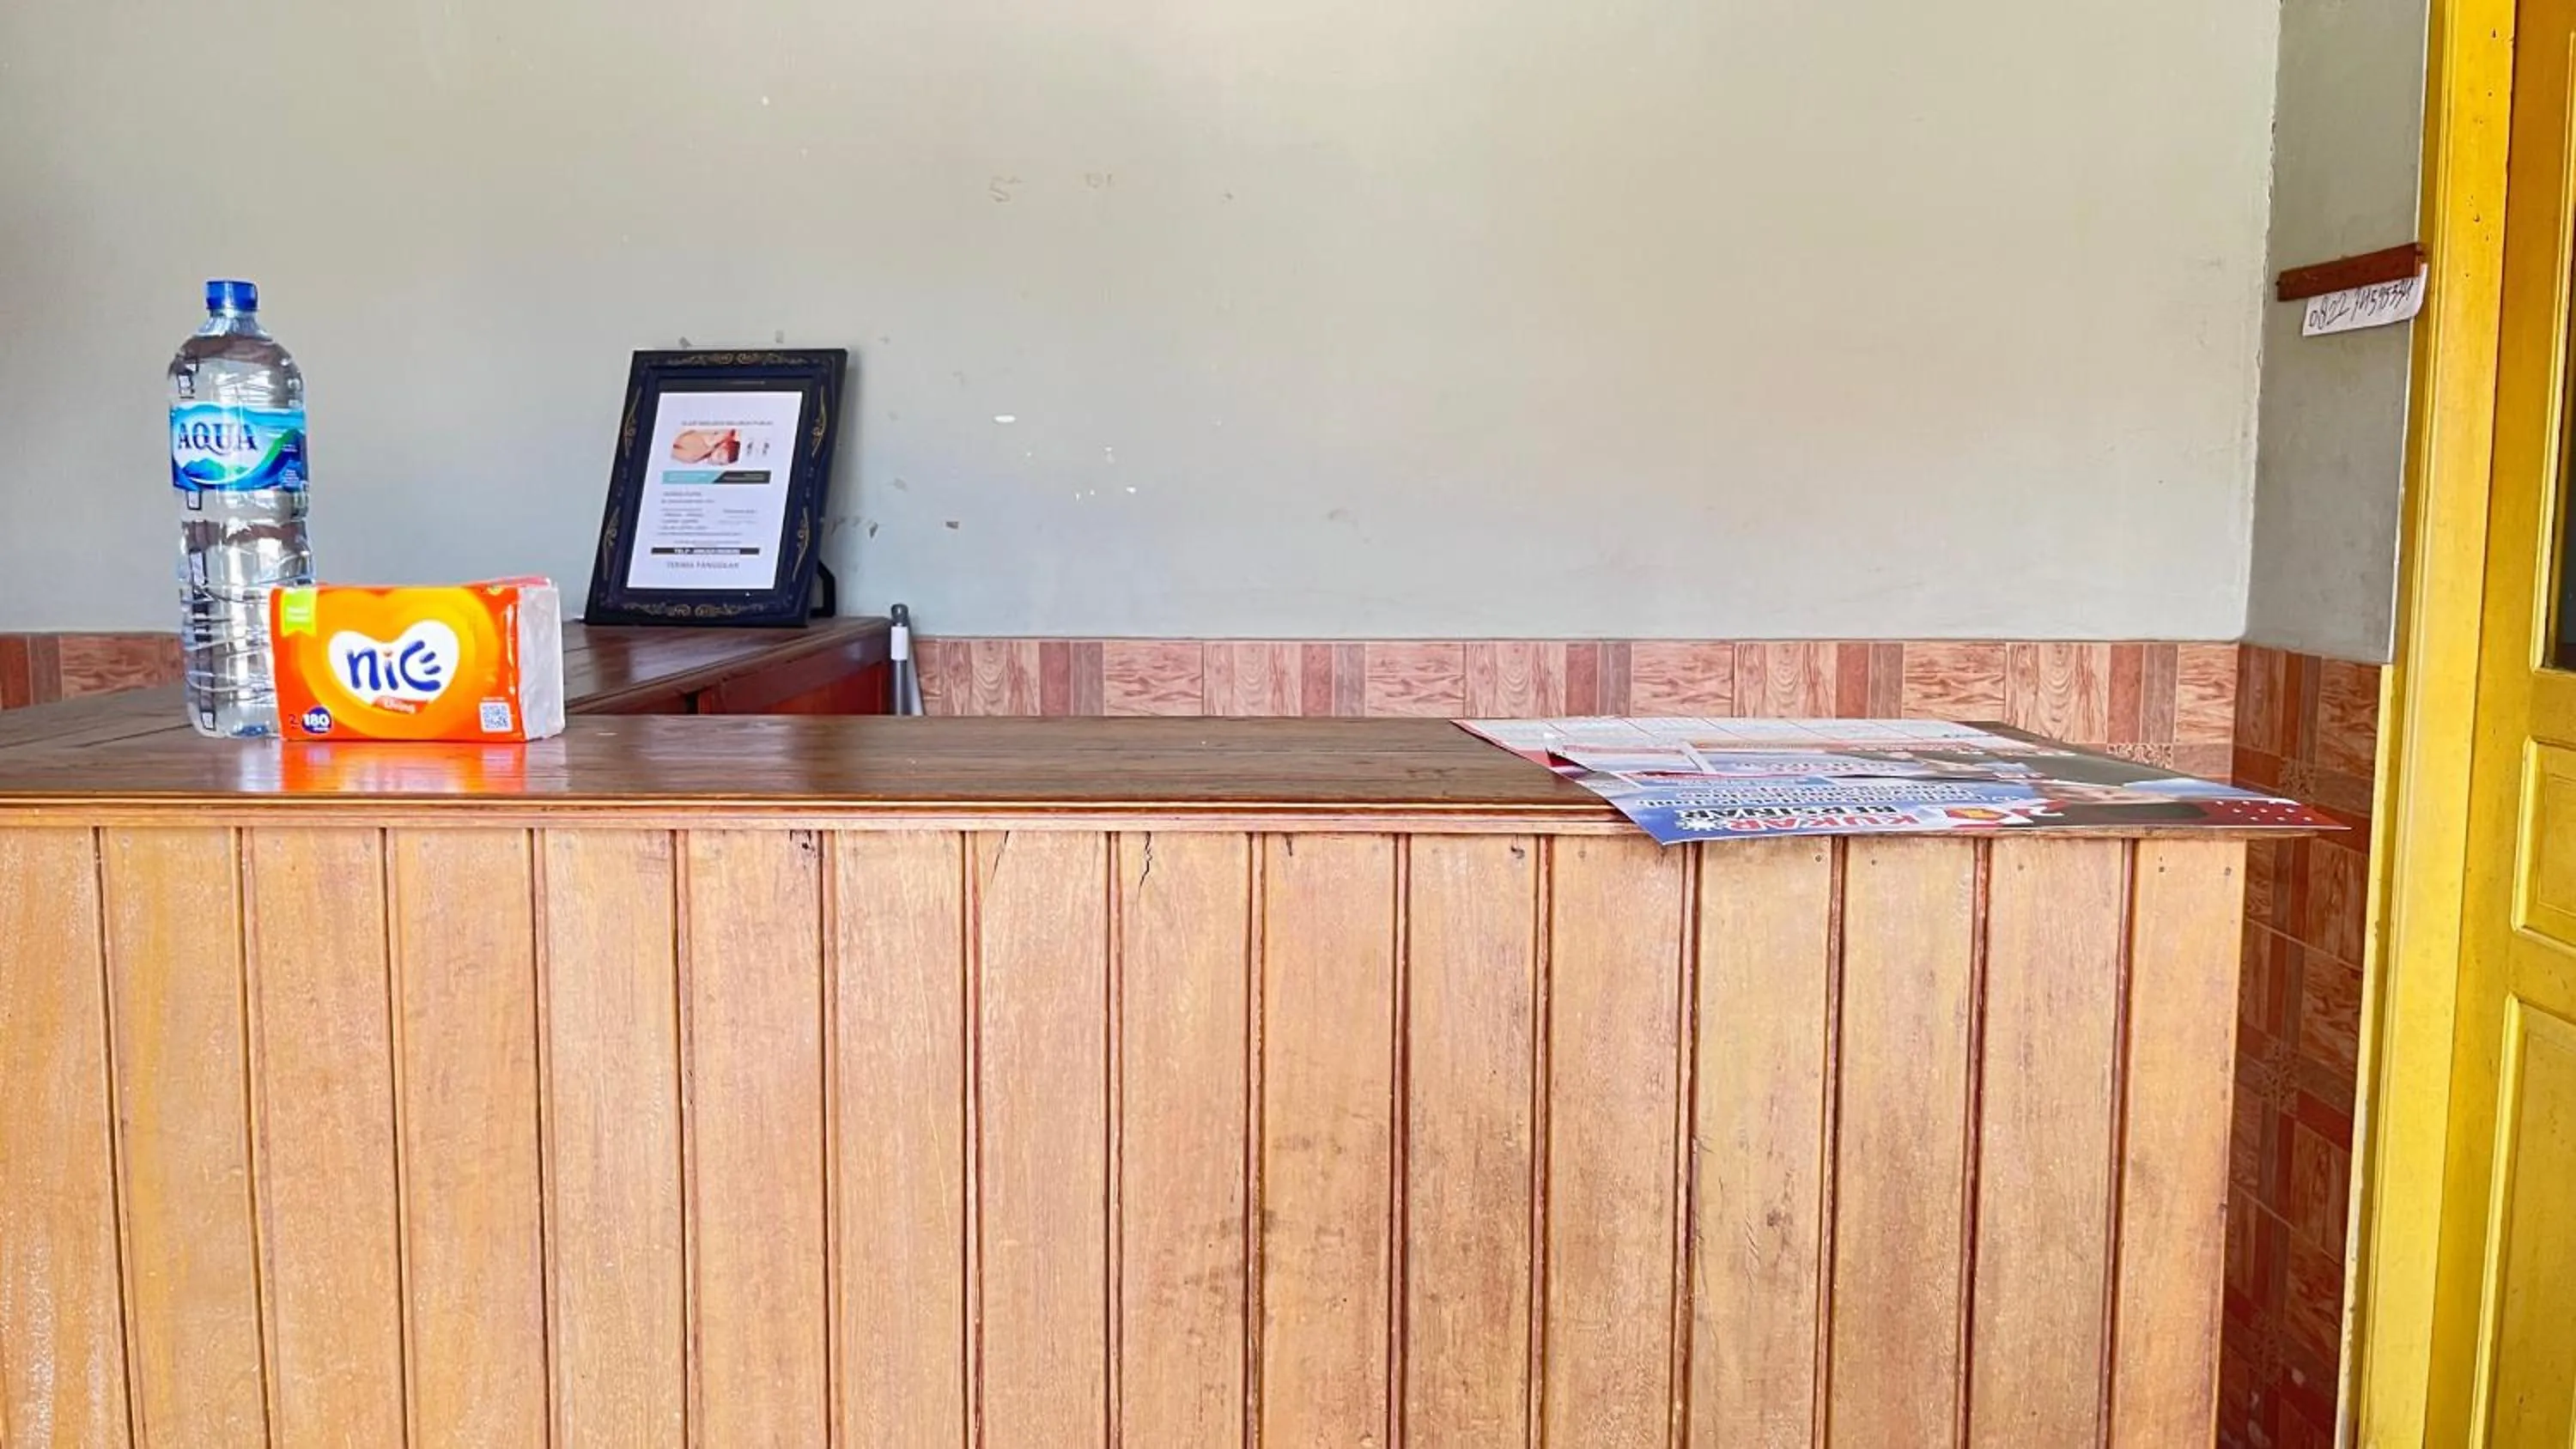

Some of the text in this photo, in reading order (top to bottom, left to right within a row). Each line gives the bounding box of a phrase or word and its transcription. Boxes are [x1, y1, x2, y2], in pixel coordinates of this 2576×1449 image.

[178, 422, 258, 455] AQUA
[302, 714, 330, 727] 180
[1726, 814, 1920, 832] KUKAR
